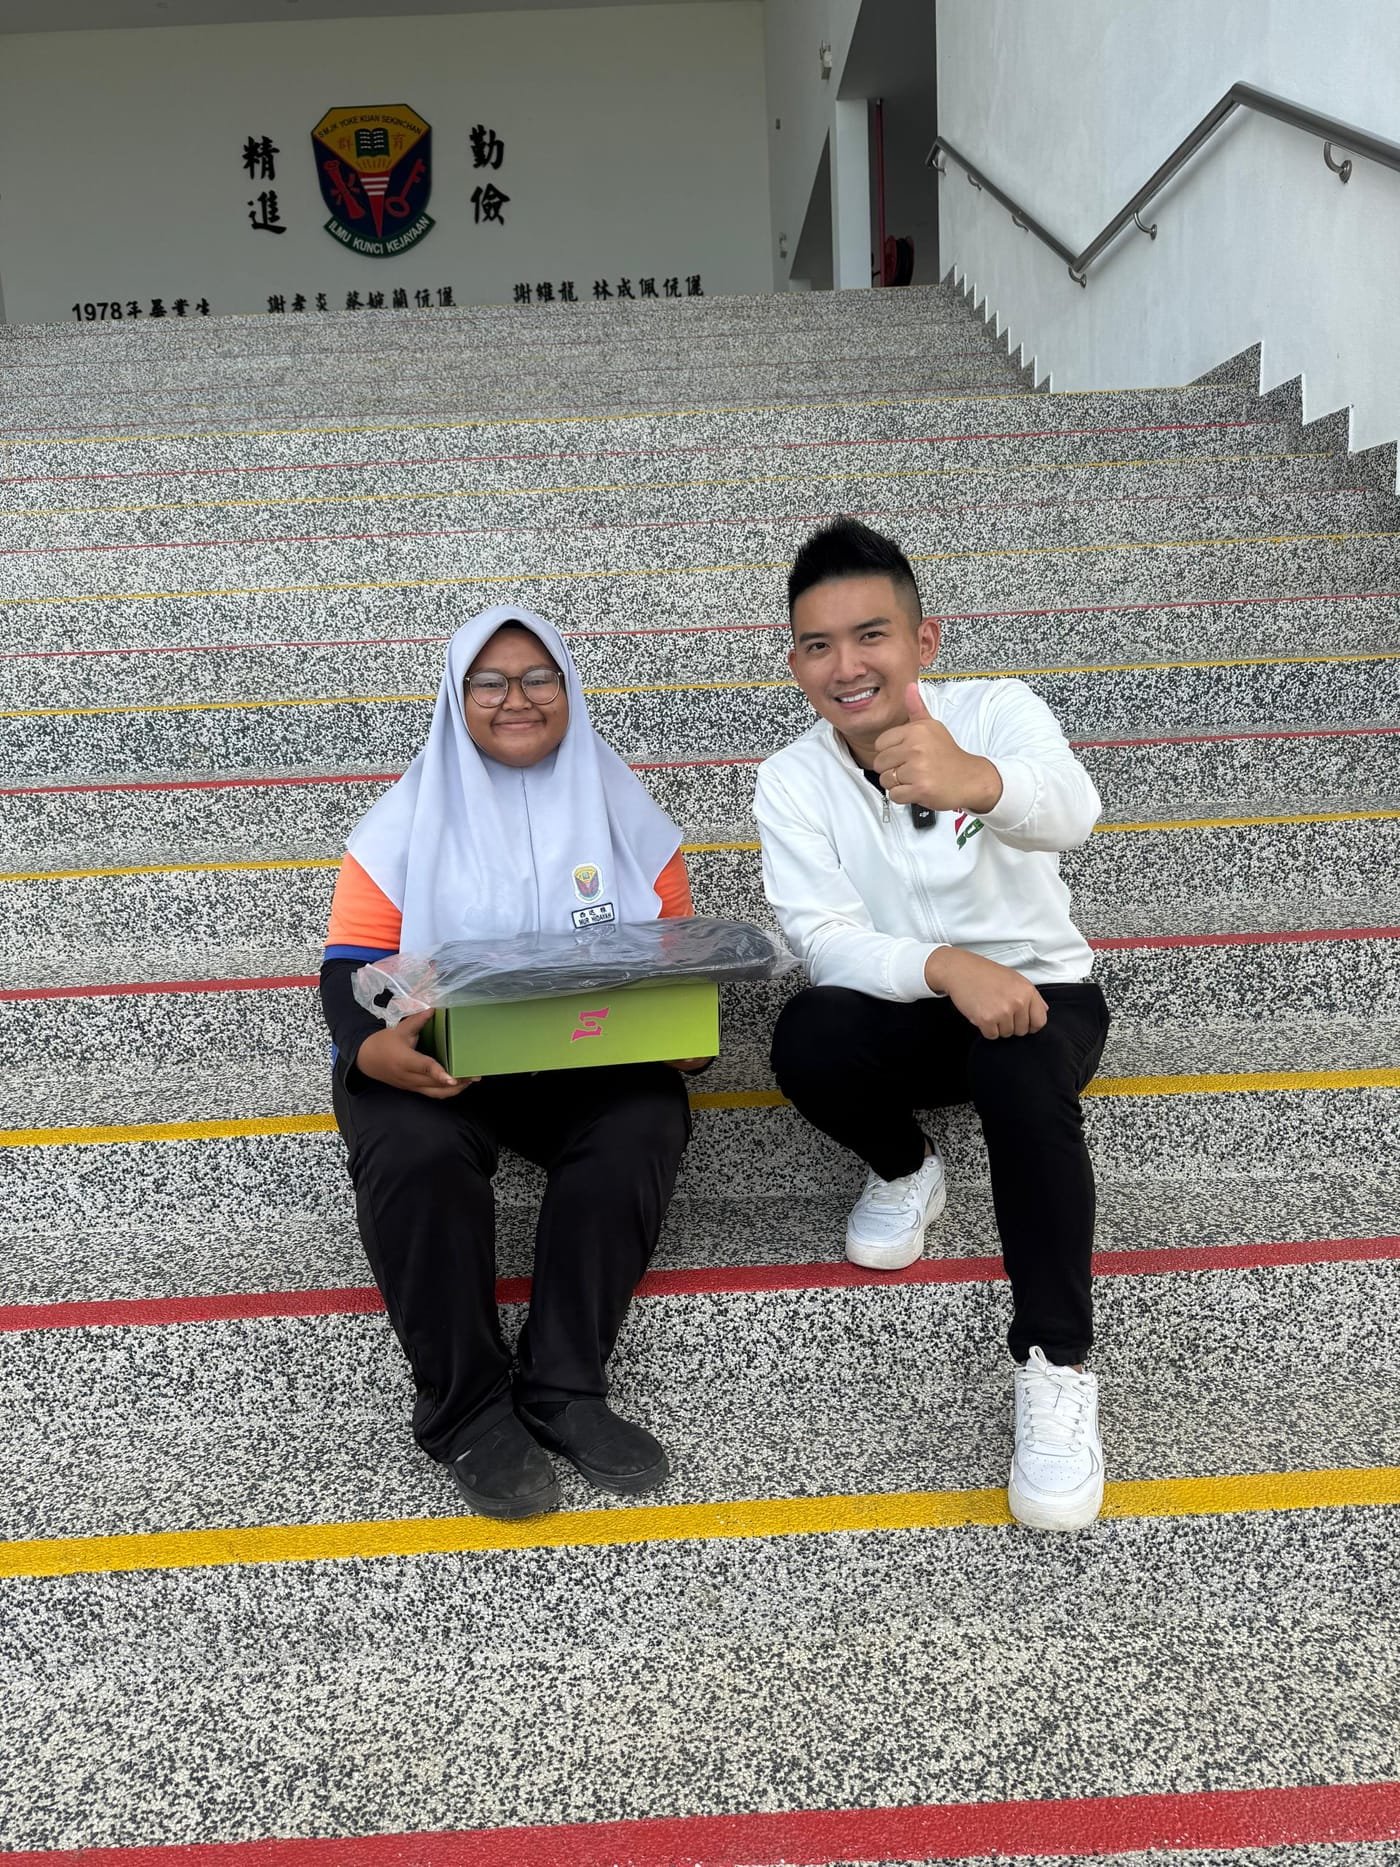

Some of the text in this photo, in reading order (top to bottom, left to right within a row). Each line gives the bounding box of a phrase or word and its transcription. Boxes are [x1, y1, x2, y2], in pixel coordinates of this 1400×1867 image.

[340, 116, 359, 129] YOKE
[360, 114, 381, 123] KUAN
[381, 114, 422, 136] SEKINCHAN
[242, 135, 287, 235] 精進
[469, 124, 511, 226] 勤儉
[328, 216, 430, 255] ILMU KUNCI KEJAYAAN
